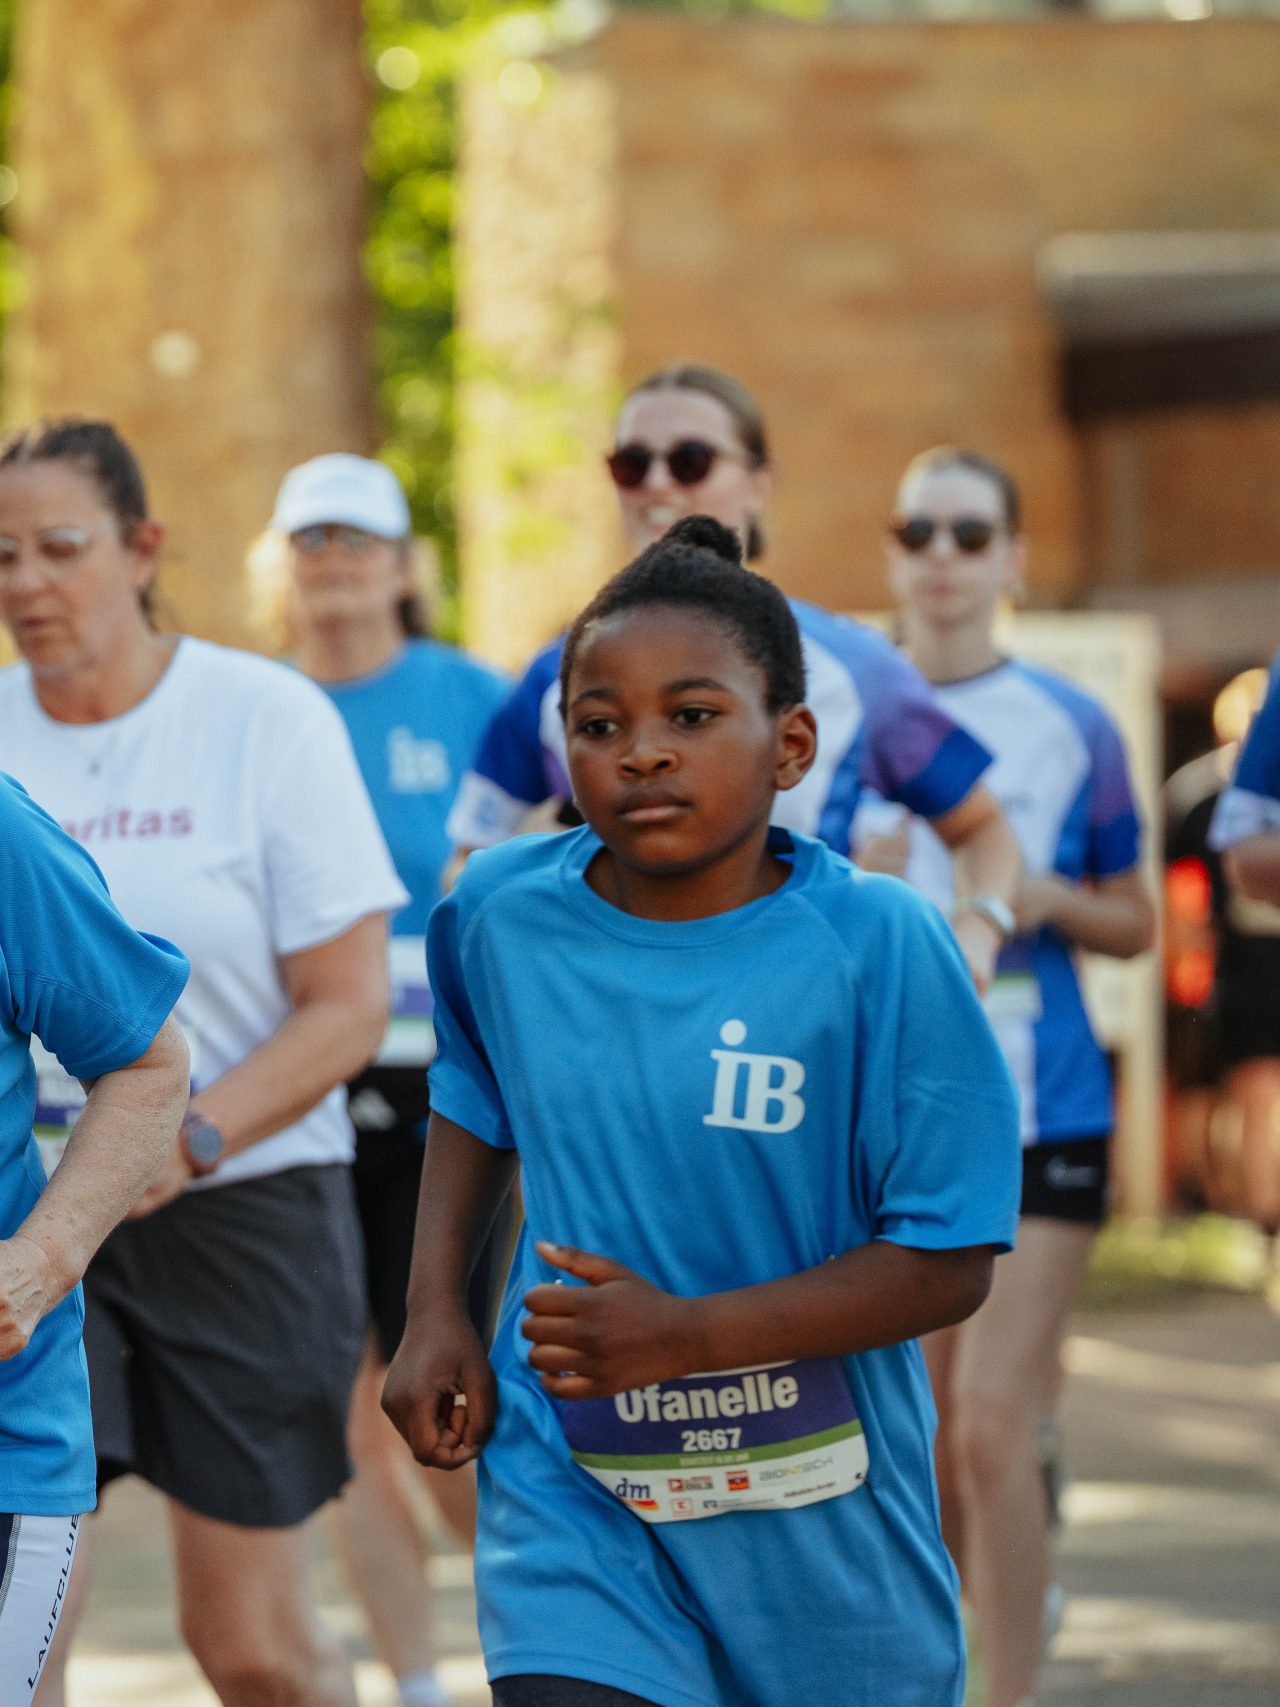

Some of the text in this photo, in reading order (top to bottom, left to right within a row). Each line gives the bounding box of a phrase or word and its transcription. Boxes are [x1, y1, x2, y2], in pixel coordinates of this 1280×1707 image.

[61, 805, 192, 841] aritas
[680, 1427, 742, 1452] 2667
[616, 1478, 650, 1499] dm
